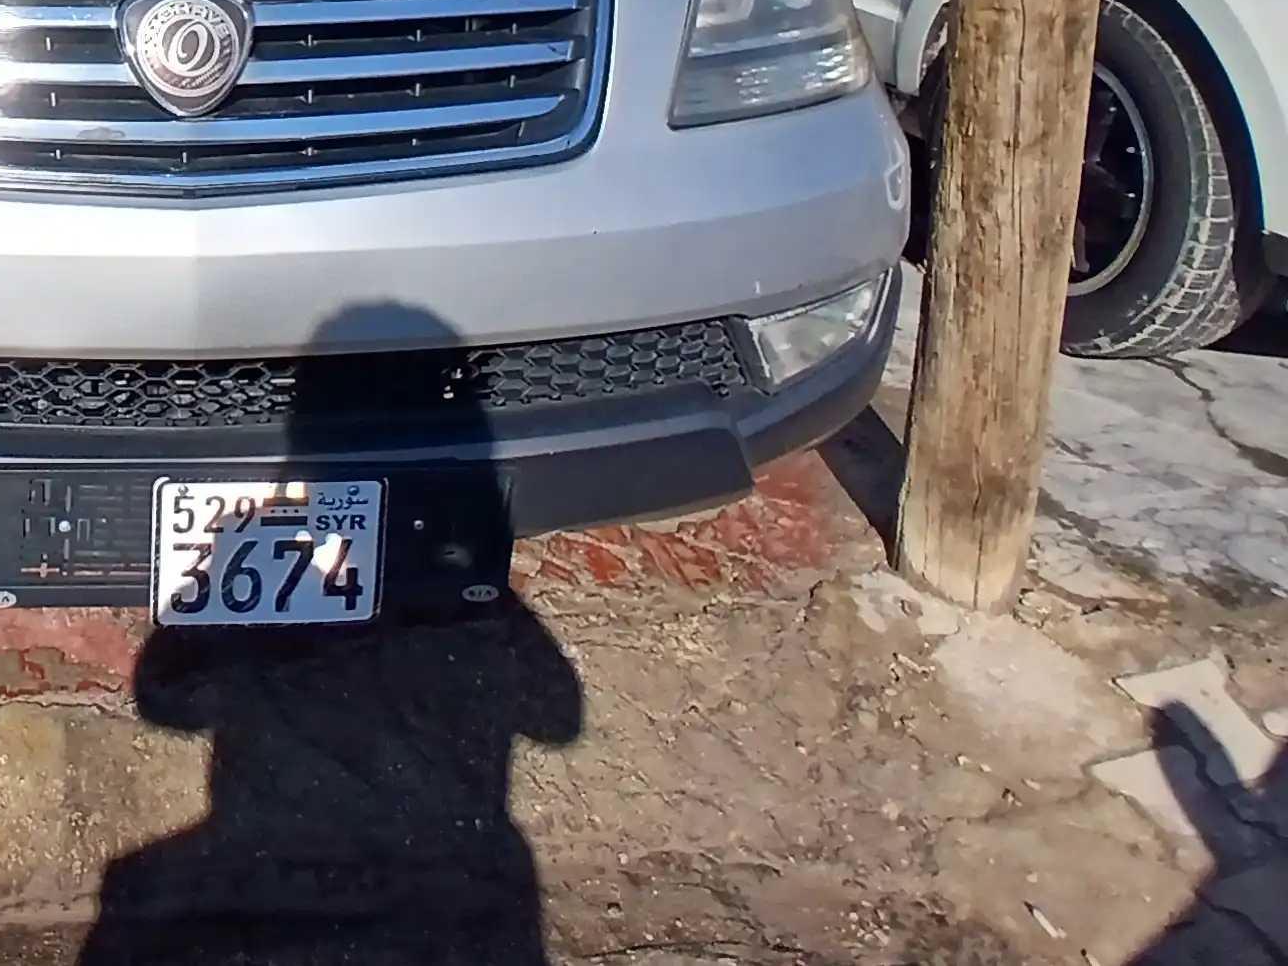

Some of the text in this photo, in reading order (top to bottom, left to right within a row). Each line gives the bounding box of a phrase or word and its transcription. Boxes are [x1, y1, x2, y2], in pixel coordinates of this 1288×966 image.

[316, 490, 369, 511] سورية
[315, 514, 367, 532] SYR
[170, 537, 364, 615] 3674
